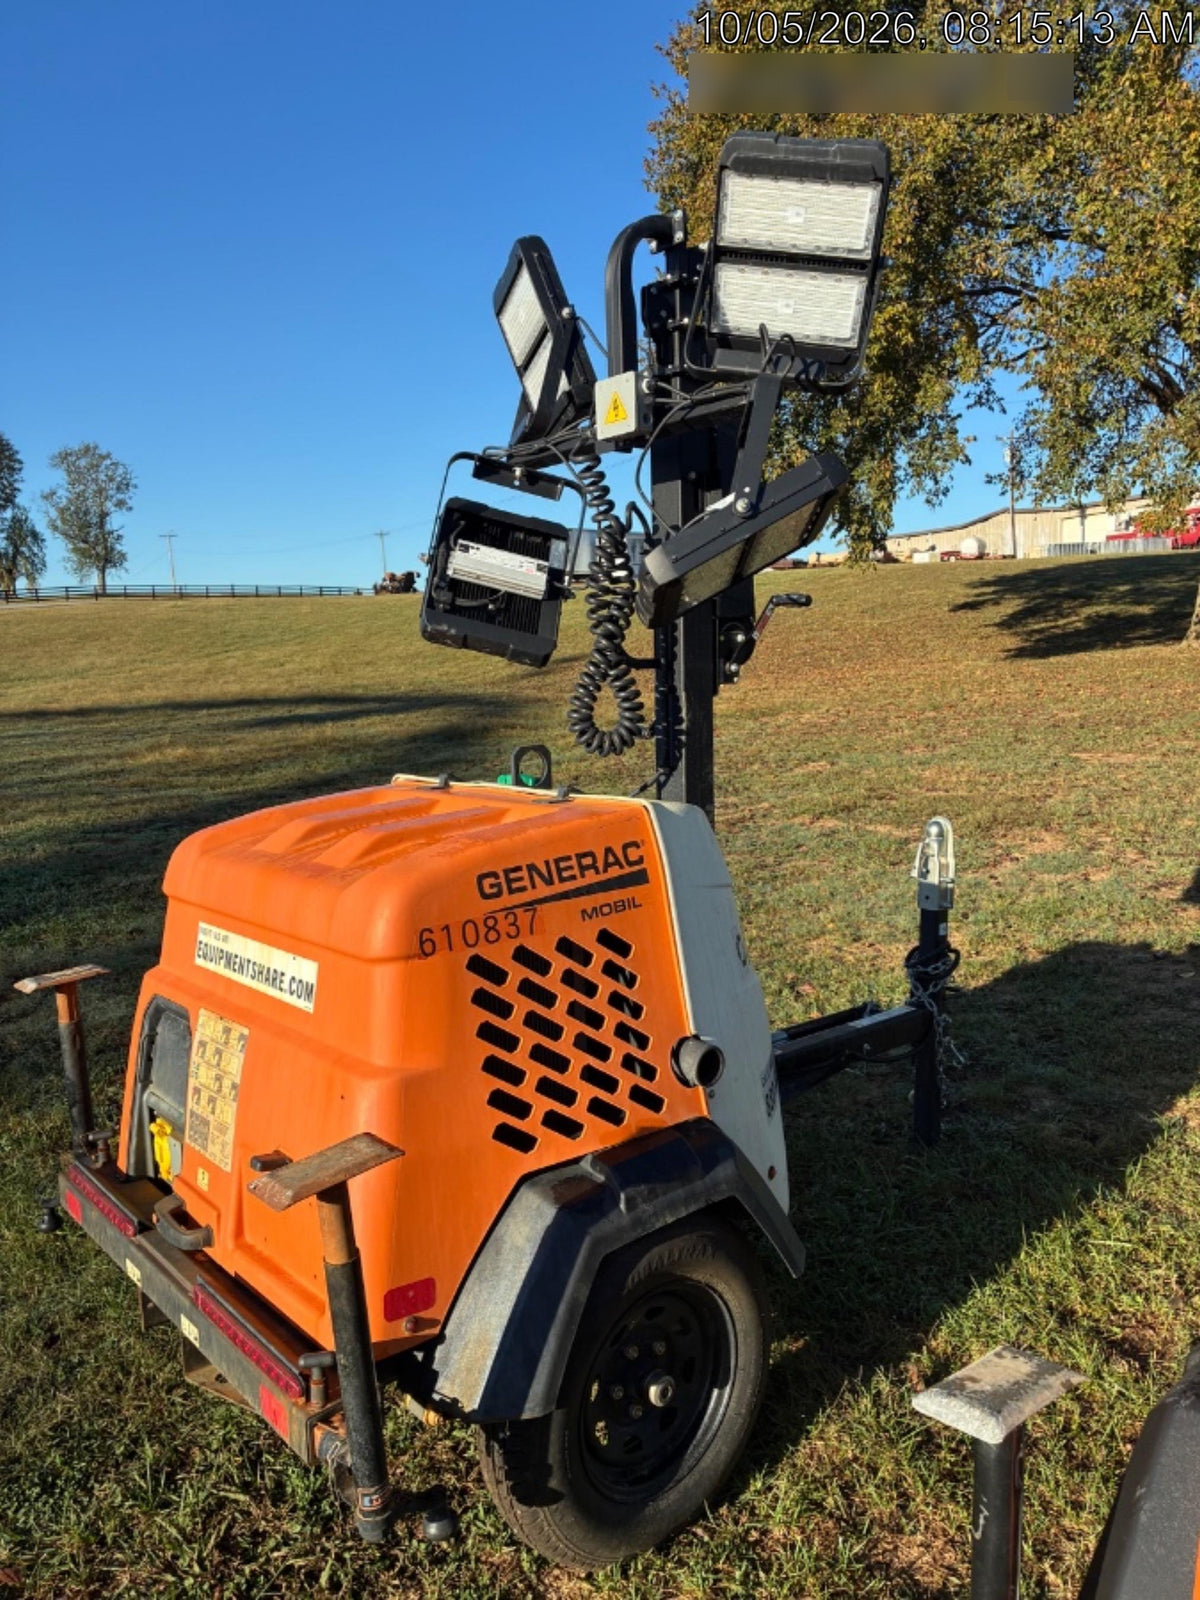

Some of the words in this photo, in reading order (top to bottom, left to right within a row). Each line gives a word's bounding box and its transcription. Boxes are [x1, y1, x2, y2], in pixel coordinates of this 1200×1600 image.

[476, 841, 645, 901] GENERAC
[419, 907, 539, 957] 610837
[581, 896, 643, 922] MOBIL
[196, 940, 314, 1004] EQUIPMENTSHARE.COM
